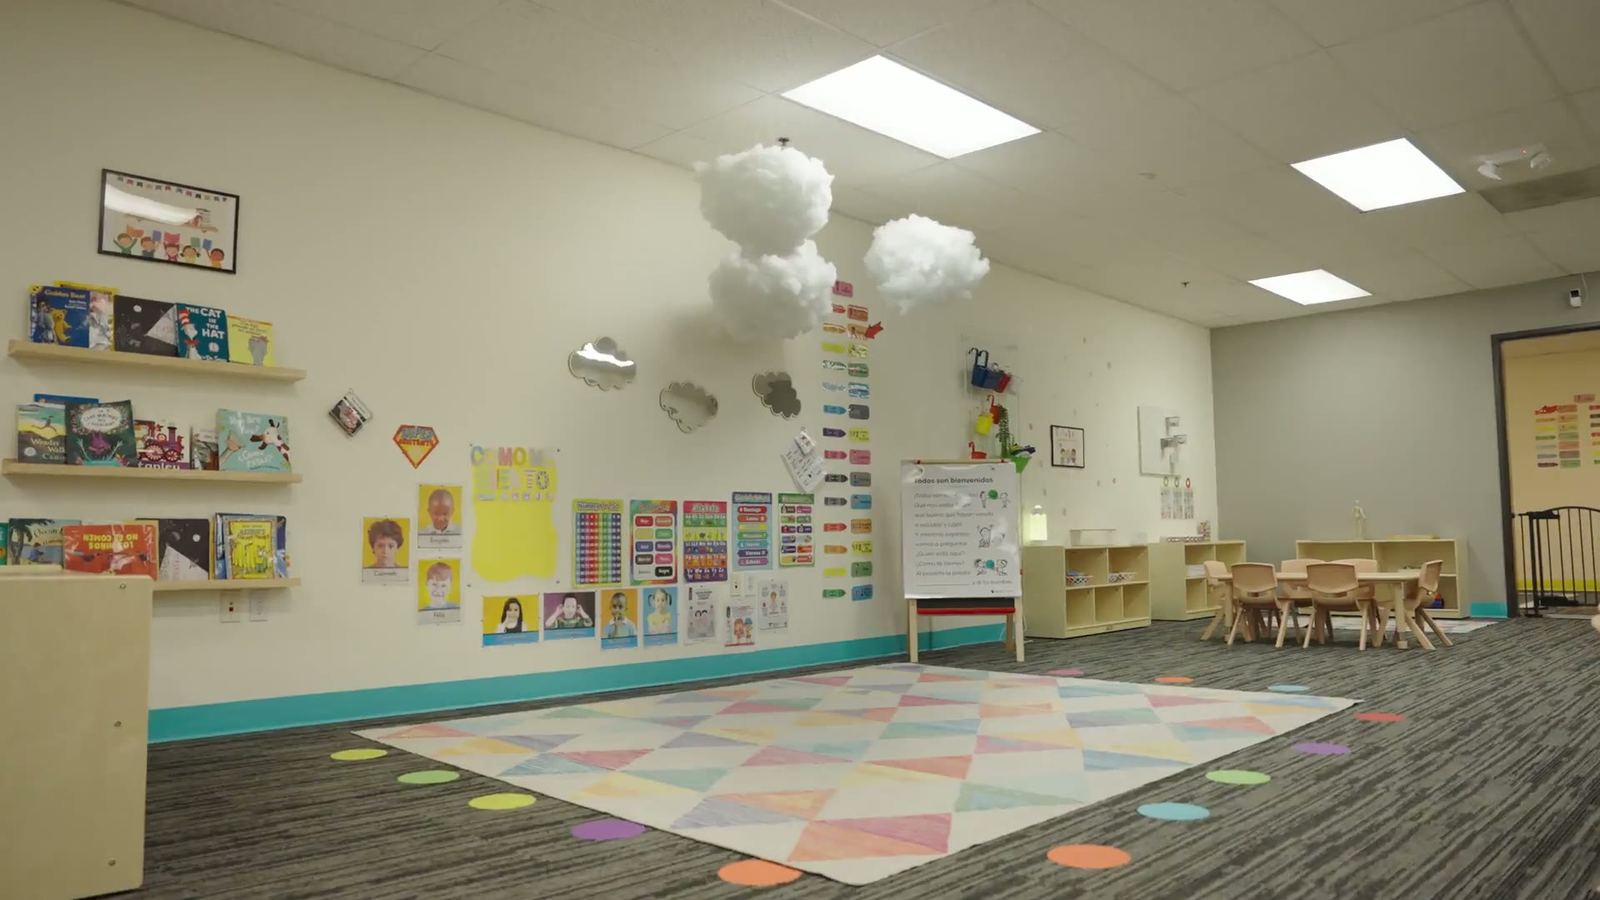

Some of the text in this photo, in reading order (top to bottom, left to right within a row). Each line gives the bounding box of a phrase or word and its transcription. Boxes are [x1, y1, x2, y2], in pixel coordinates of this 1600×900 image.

[200, 308, 222, 318] CAT
[201, 328, 225, 339] HAT
[138, 461, 181, 470] tanley
[83, 533, 112, 541] COMEN
